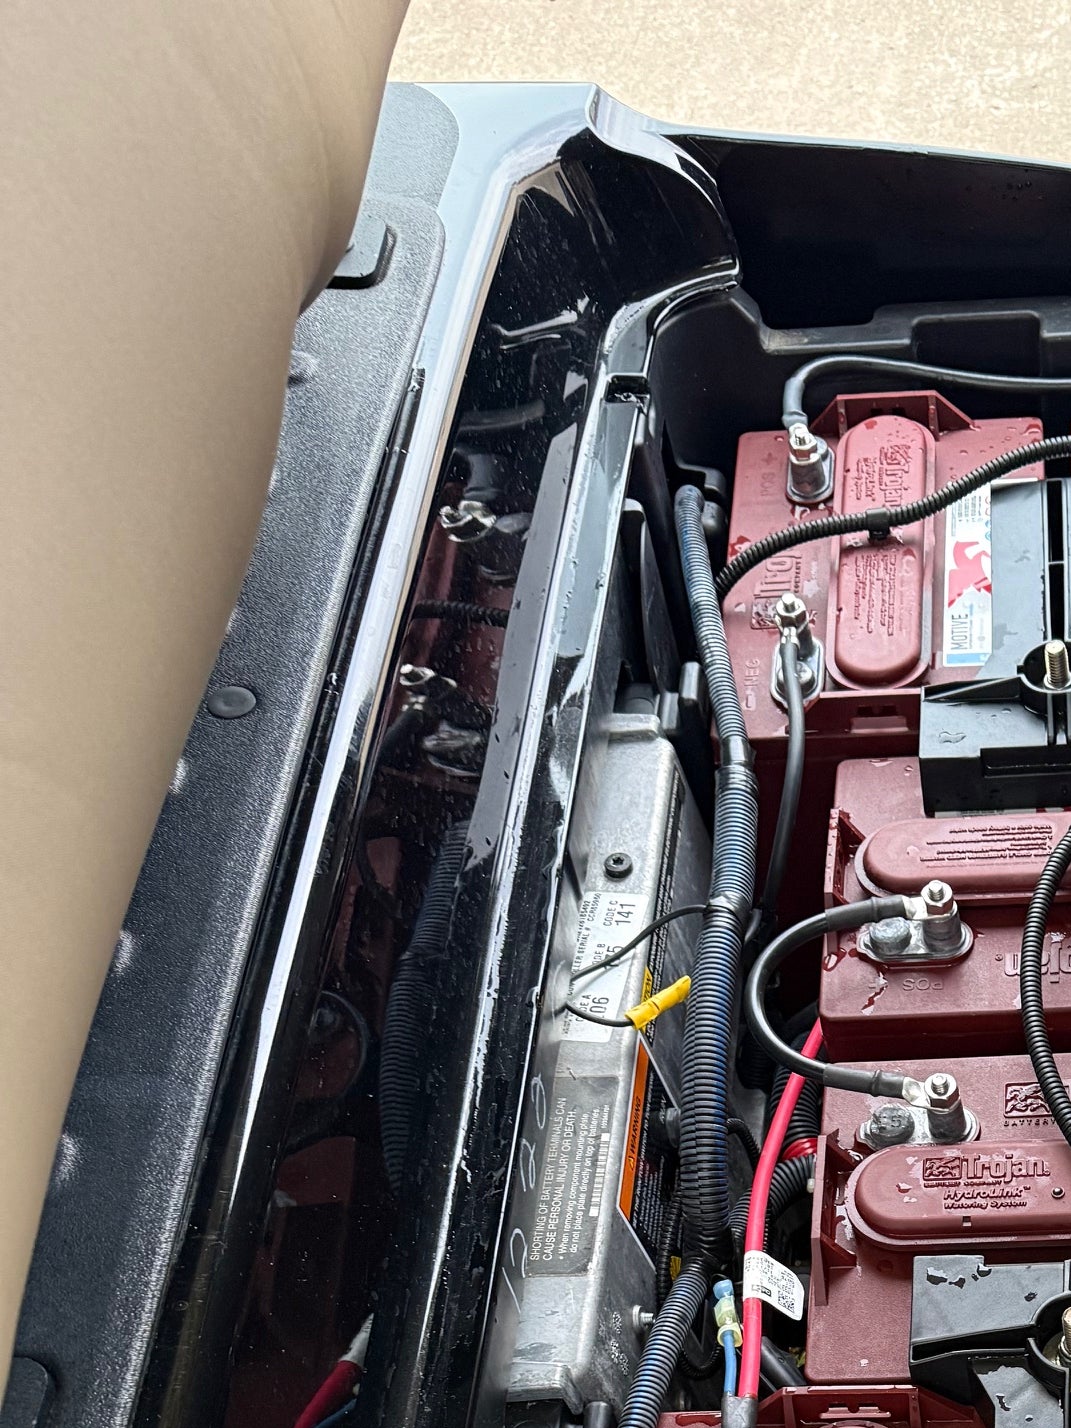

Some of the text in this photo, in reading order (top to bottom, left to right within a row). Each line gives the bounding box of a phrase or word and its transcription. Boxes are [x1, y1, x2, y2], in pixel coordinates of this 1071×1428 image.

[951, 614, 968, 650] MOTIVE
[603, 907, 616, 926] CODE
[615, 903, 635, 925] 141
[902, 978, 943, 990] POS
[586, 1107, 599, 1136] batteries.
[629, 1096, 641, 1154] WARNING
[575, 1131, 587, 1160] mounting
[585, 1146, 595, 1156] top
[530, 1098, 567, 1260] SHORTING OF BATTERY TERMINALS CAN
[961, 1154, 1046, 1181] Trojan
[543, 1109, 577, 1260] CAUSE PERSONAL INJURY OR DEATH.
[566, 1162, 581, 1199] component
[579, 1168, 592, 1192] directly
[576, 1193, 587, 1210] plate
[944, 1188, 1022, 1200] HydroLink
[562, 1200, 576, 1231] removing
[572, 1211, 584, 1229] place
[559, 1233, 568, 1253] When
[571, 1231, 581, 1242] not
[570, 1244, 578, 1253] do
